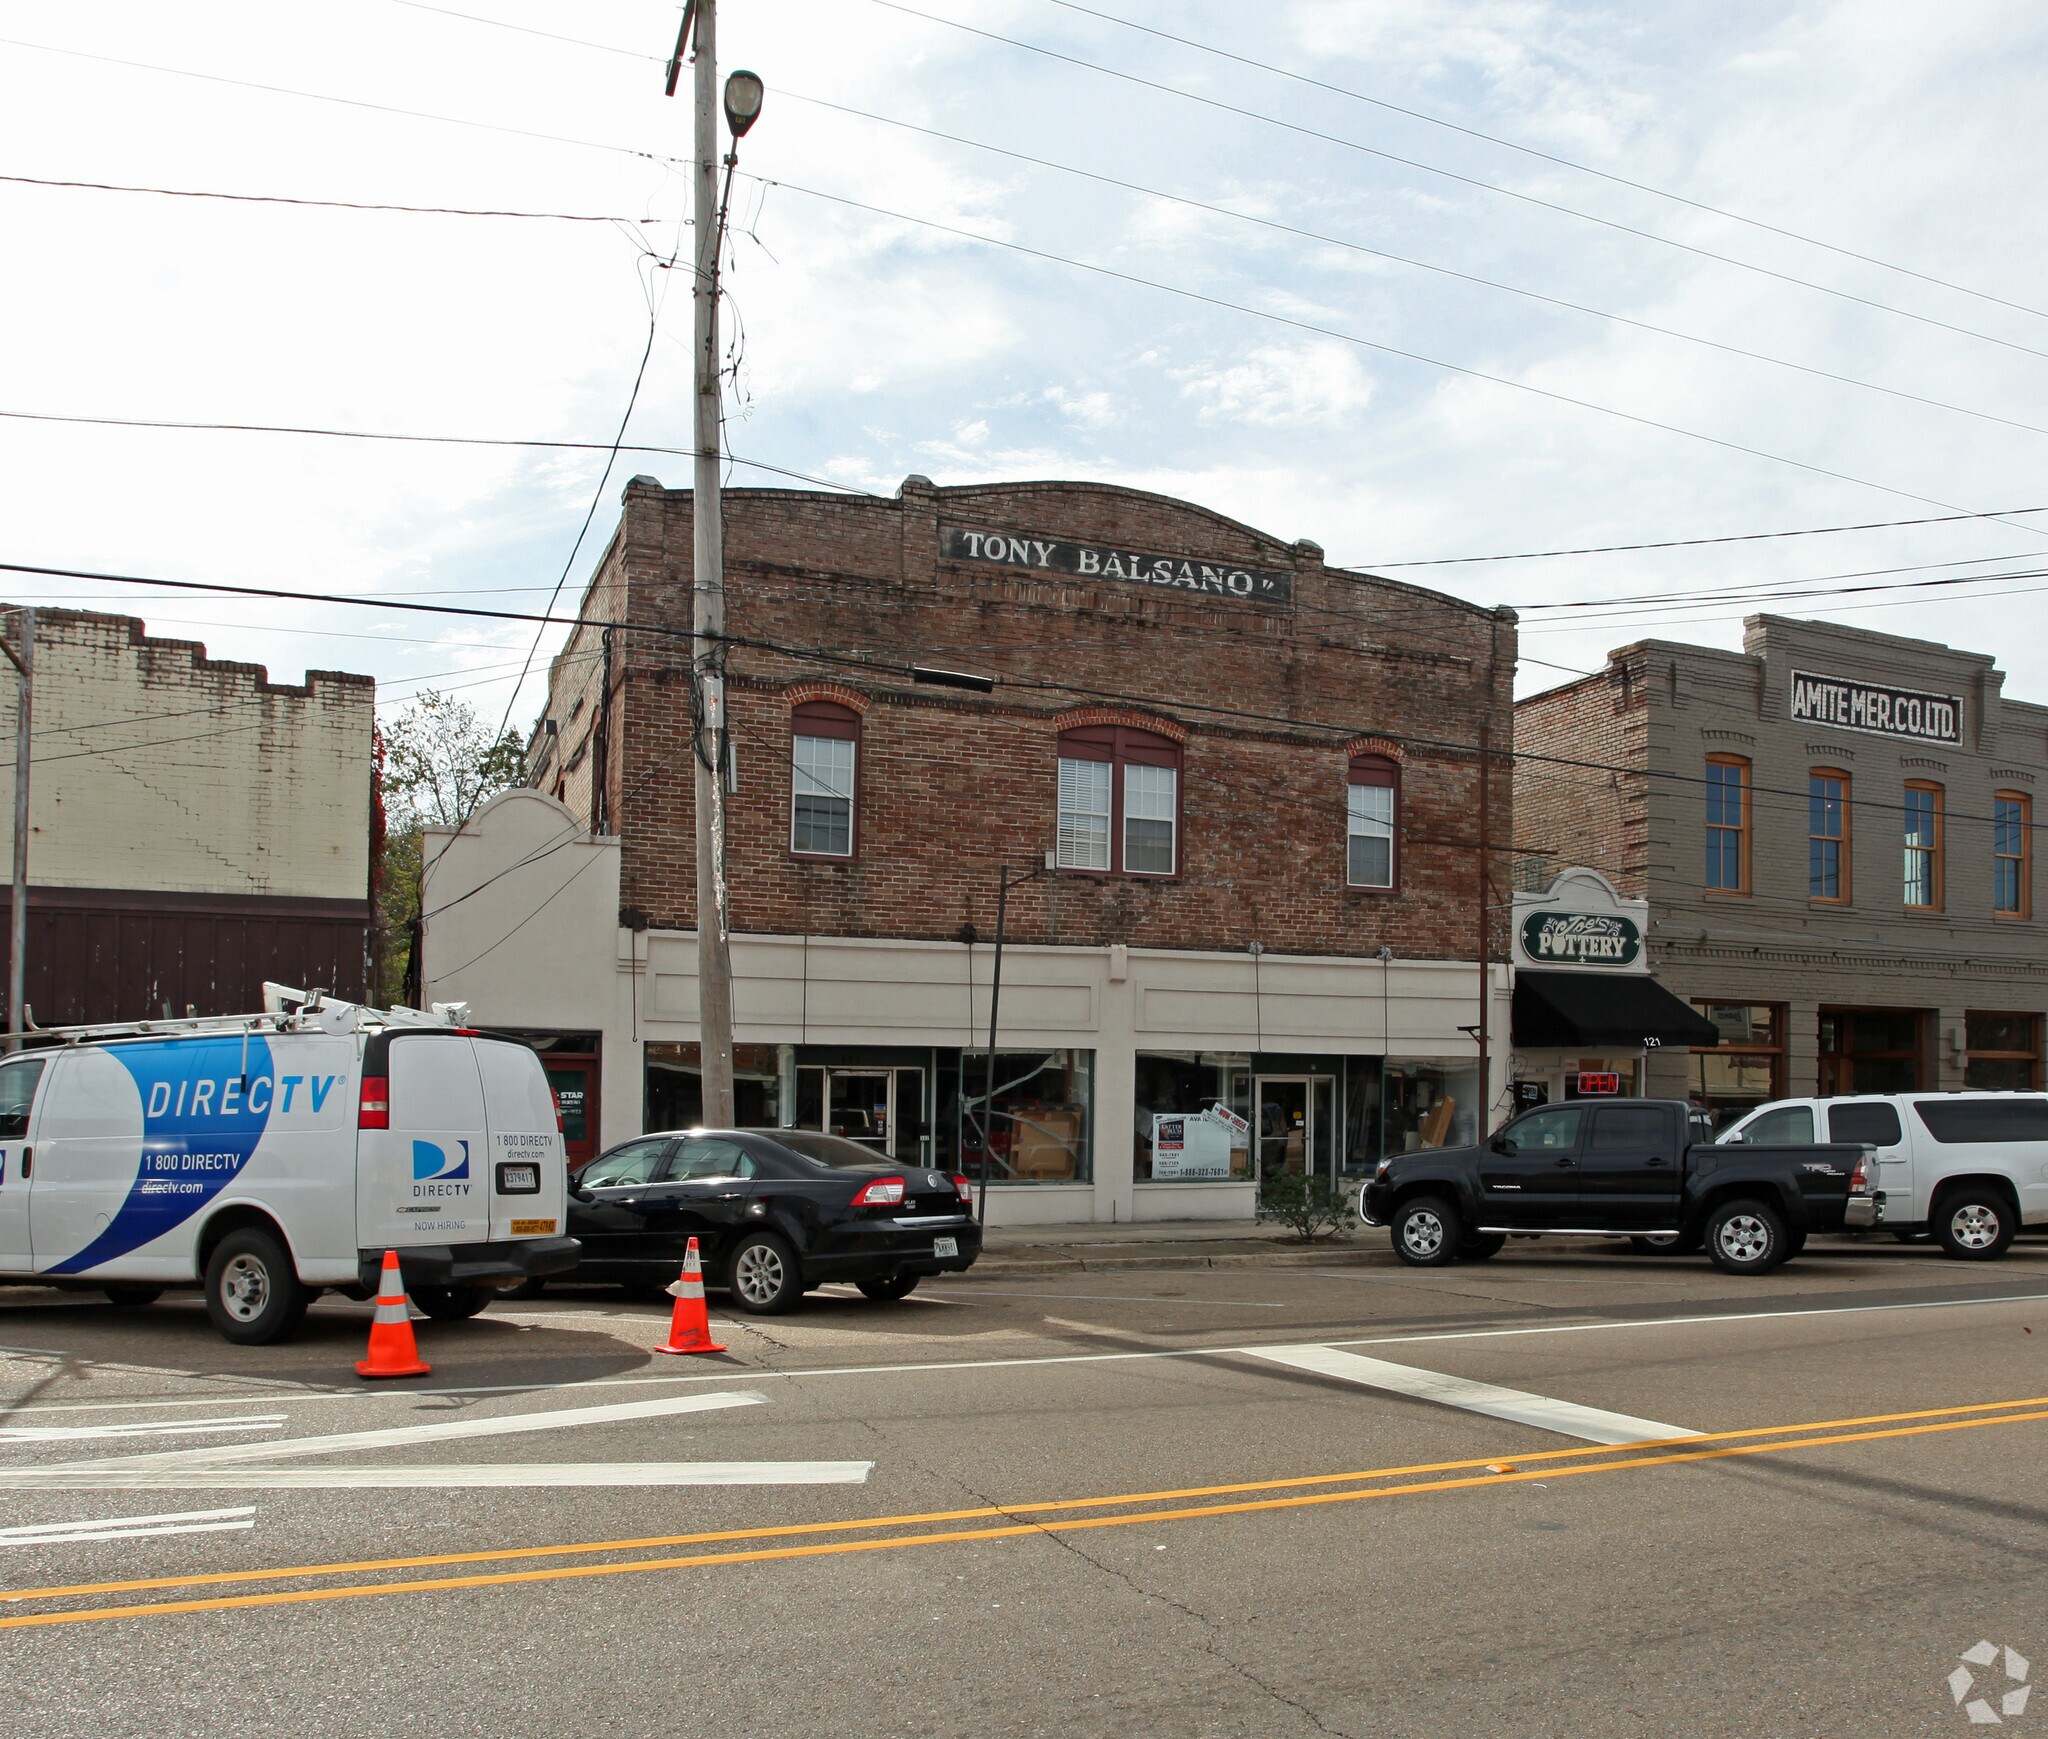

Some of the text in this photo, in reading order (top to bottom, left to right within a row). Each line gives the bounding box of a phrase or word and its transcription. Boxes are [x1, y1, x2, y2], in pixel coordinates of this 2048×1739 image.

[964, 532, 1254, 596] TONY BALSANO
[1793, 679, 1848, 723] AMITE
[1555, 915, 1610, 936] Joe's
[1643, 1037, 1661, 1047] 121
[1579, 1074, 1618, 1092] OPEN
[496, 1135, 553, 1146] 1 800 DIRECTV
[507, 1149, 545, 1158] directv.com
[145, 1153, 240, 1171] 1 800 DIRECTV
[142, 1181, 203, 1194] directv.com
[413, 1184, 470, 1197] DIRECTV
[415, 1220, 466, 1231] NOW HIRING
